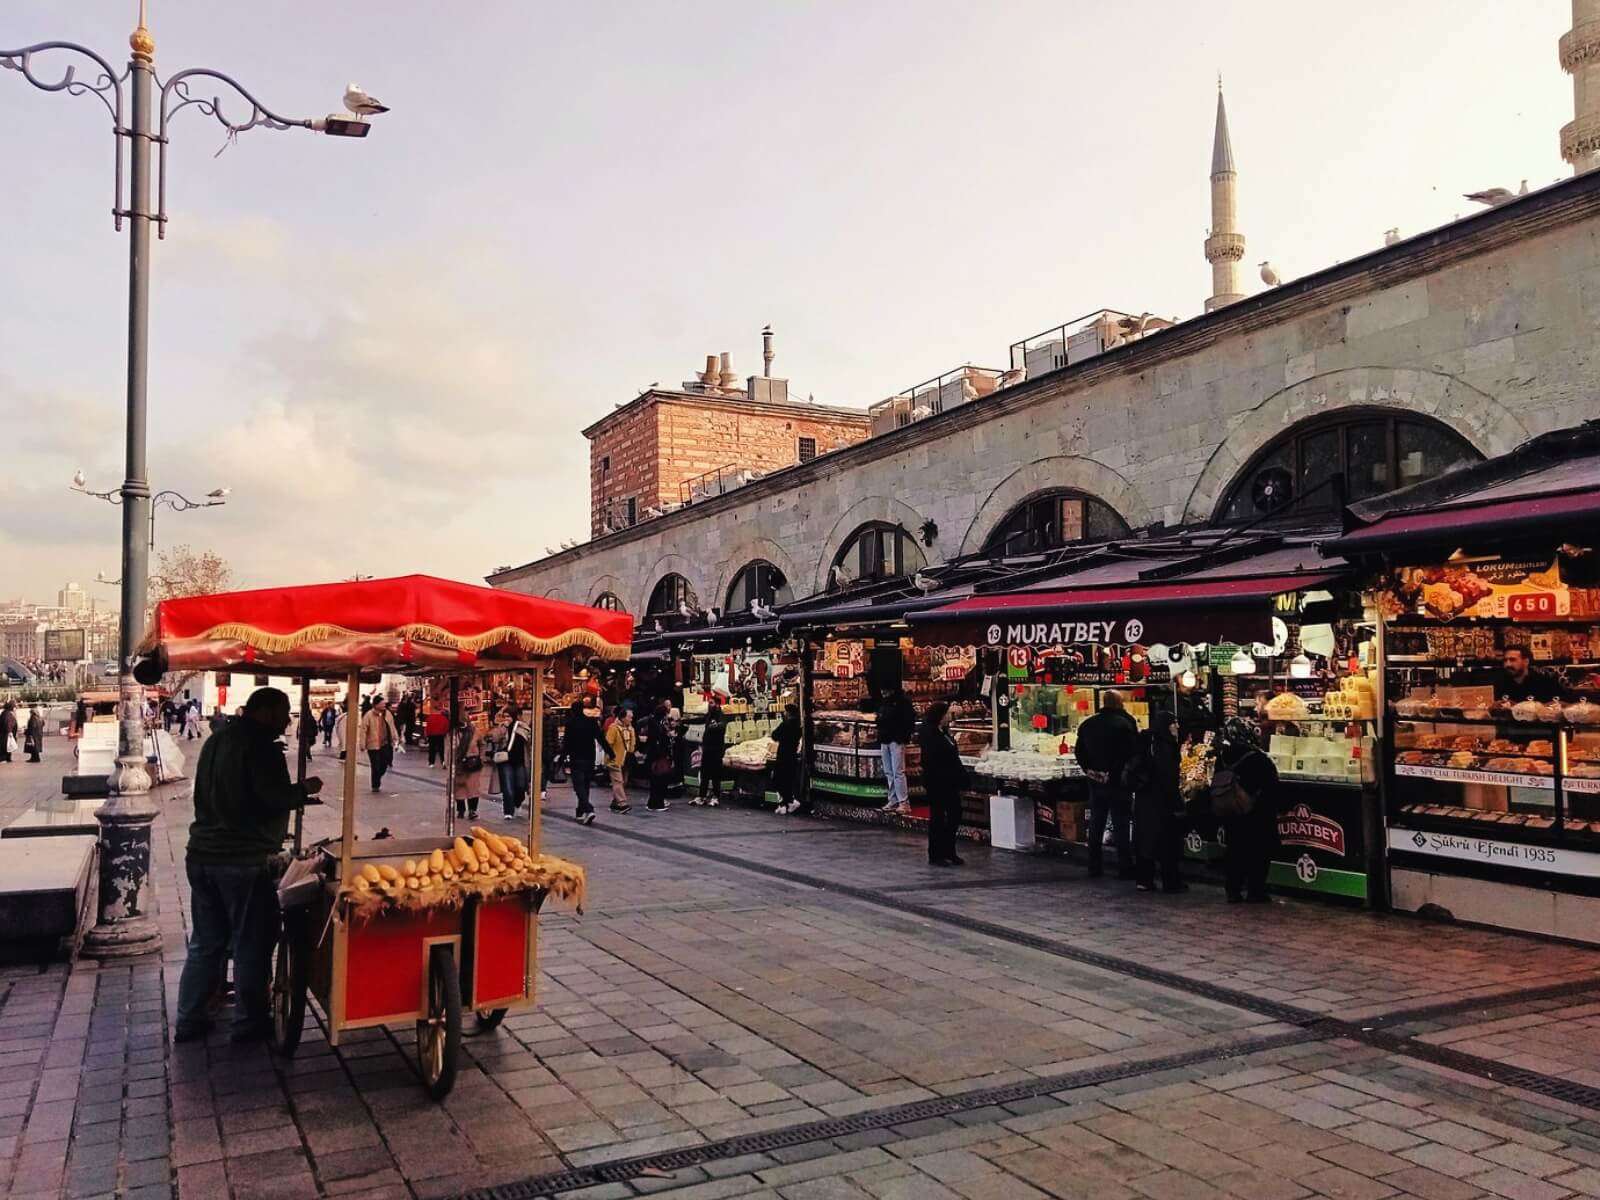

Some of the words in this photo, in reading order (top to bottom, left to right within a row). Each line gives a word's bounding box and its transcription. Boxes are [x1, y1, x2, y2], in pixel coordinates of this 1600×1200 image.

[1476, 563, 1514, 573] LOKUM
[1513, 598, 1548, 612] 650
[1006, 621, 1116, 644] MURATBEY
[1127, 624, 1140, 638] 13
[1010, 649, 1026, 666] 13
[1420, 768, 1451, 778] SPECIAL
[1453, 771, 1487, 782] TURKISH
[1488, 775, 1523, 785] DELIGHT
[1576, 781, 1600, 790] TURK
[1431, 834, 1470, 851] Şükrü
[1474, 842, 1519, 858] Efendi
[1524, 848, 1556, 863] 1935
[1298, 862, 1315, 879] 13
